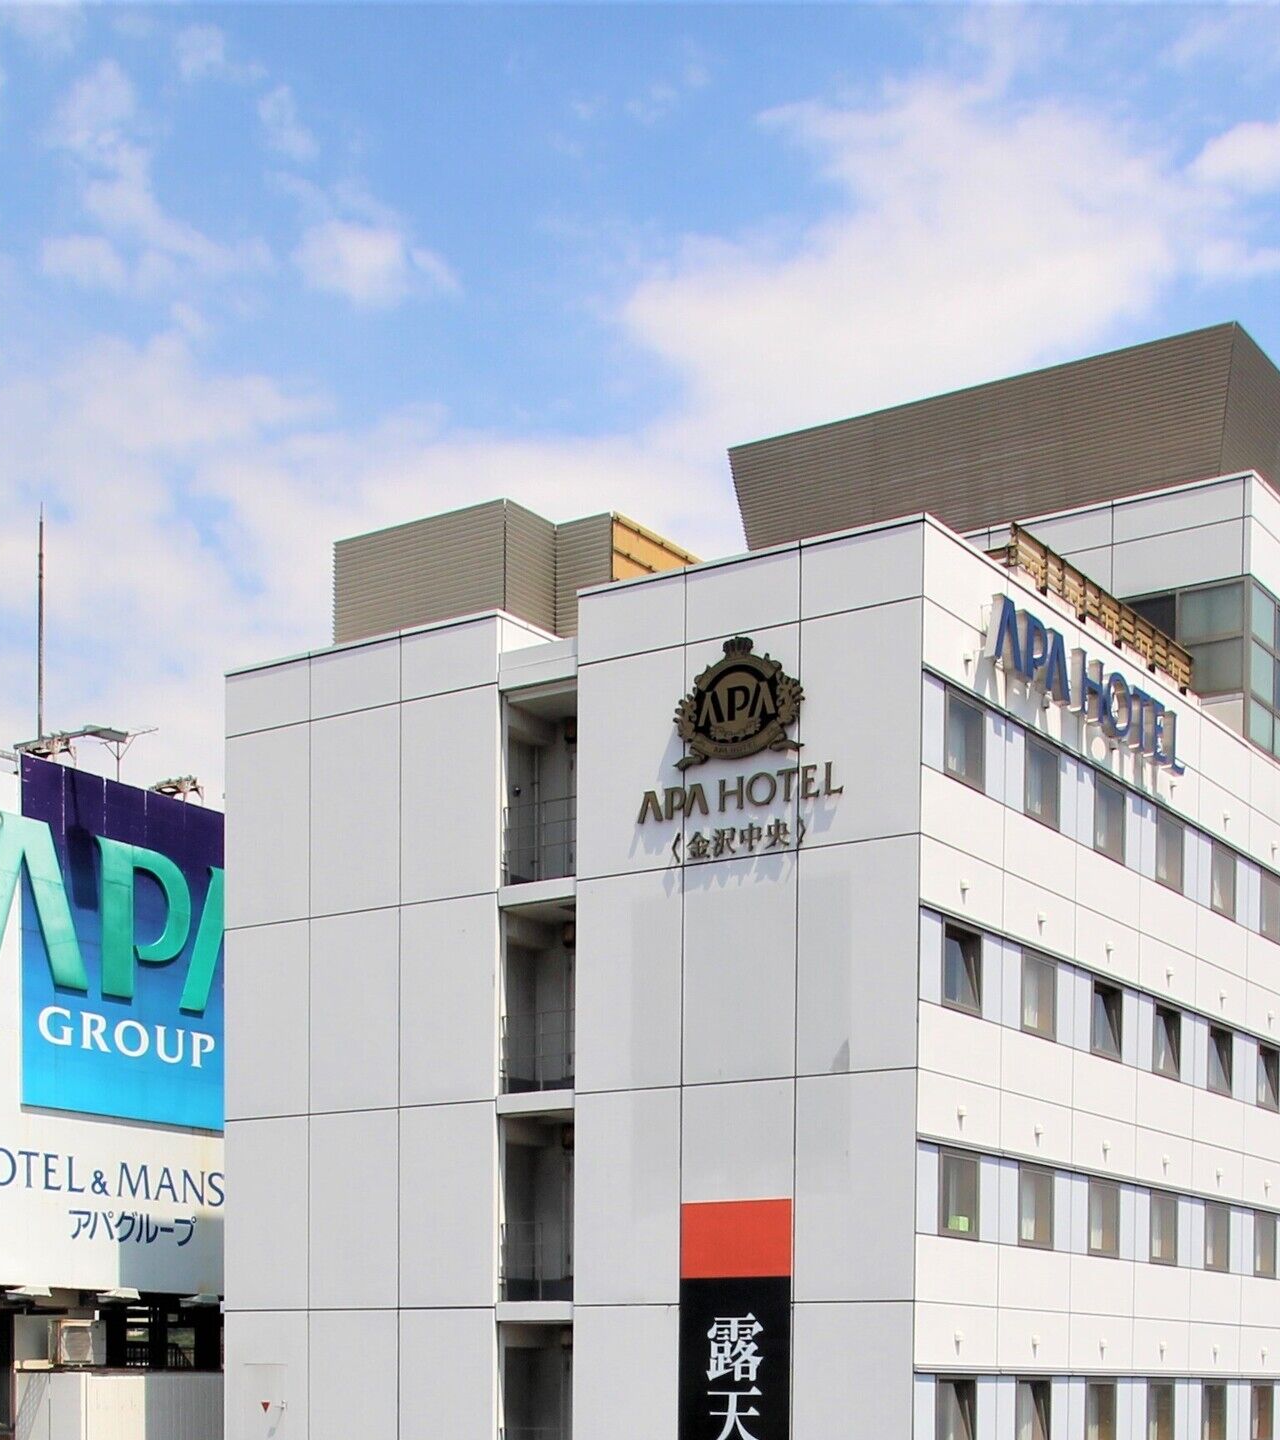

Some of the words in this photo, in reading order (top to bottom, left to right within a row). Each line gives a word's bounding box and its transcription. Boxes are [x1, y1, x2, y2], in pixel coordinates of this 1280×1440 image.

[696, 680, 779, 730] APA
[985, 593, 1070, 706] APA
[1071, 648, 1185, 776] HOTEL
[638, 790, 709, 825] APA
[718, 761, 844, 814] HOTEL
[38, 1005, 215, 1069] GROUP
[91, 1169, 108, 1195] &
[68, 1210, 197, 1247] アパグループ
